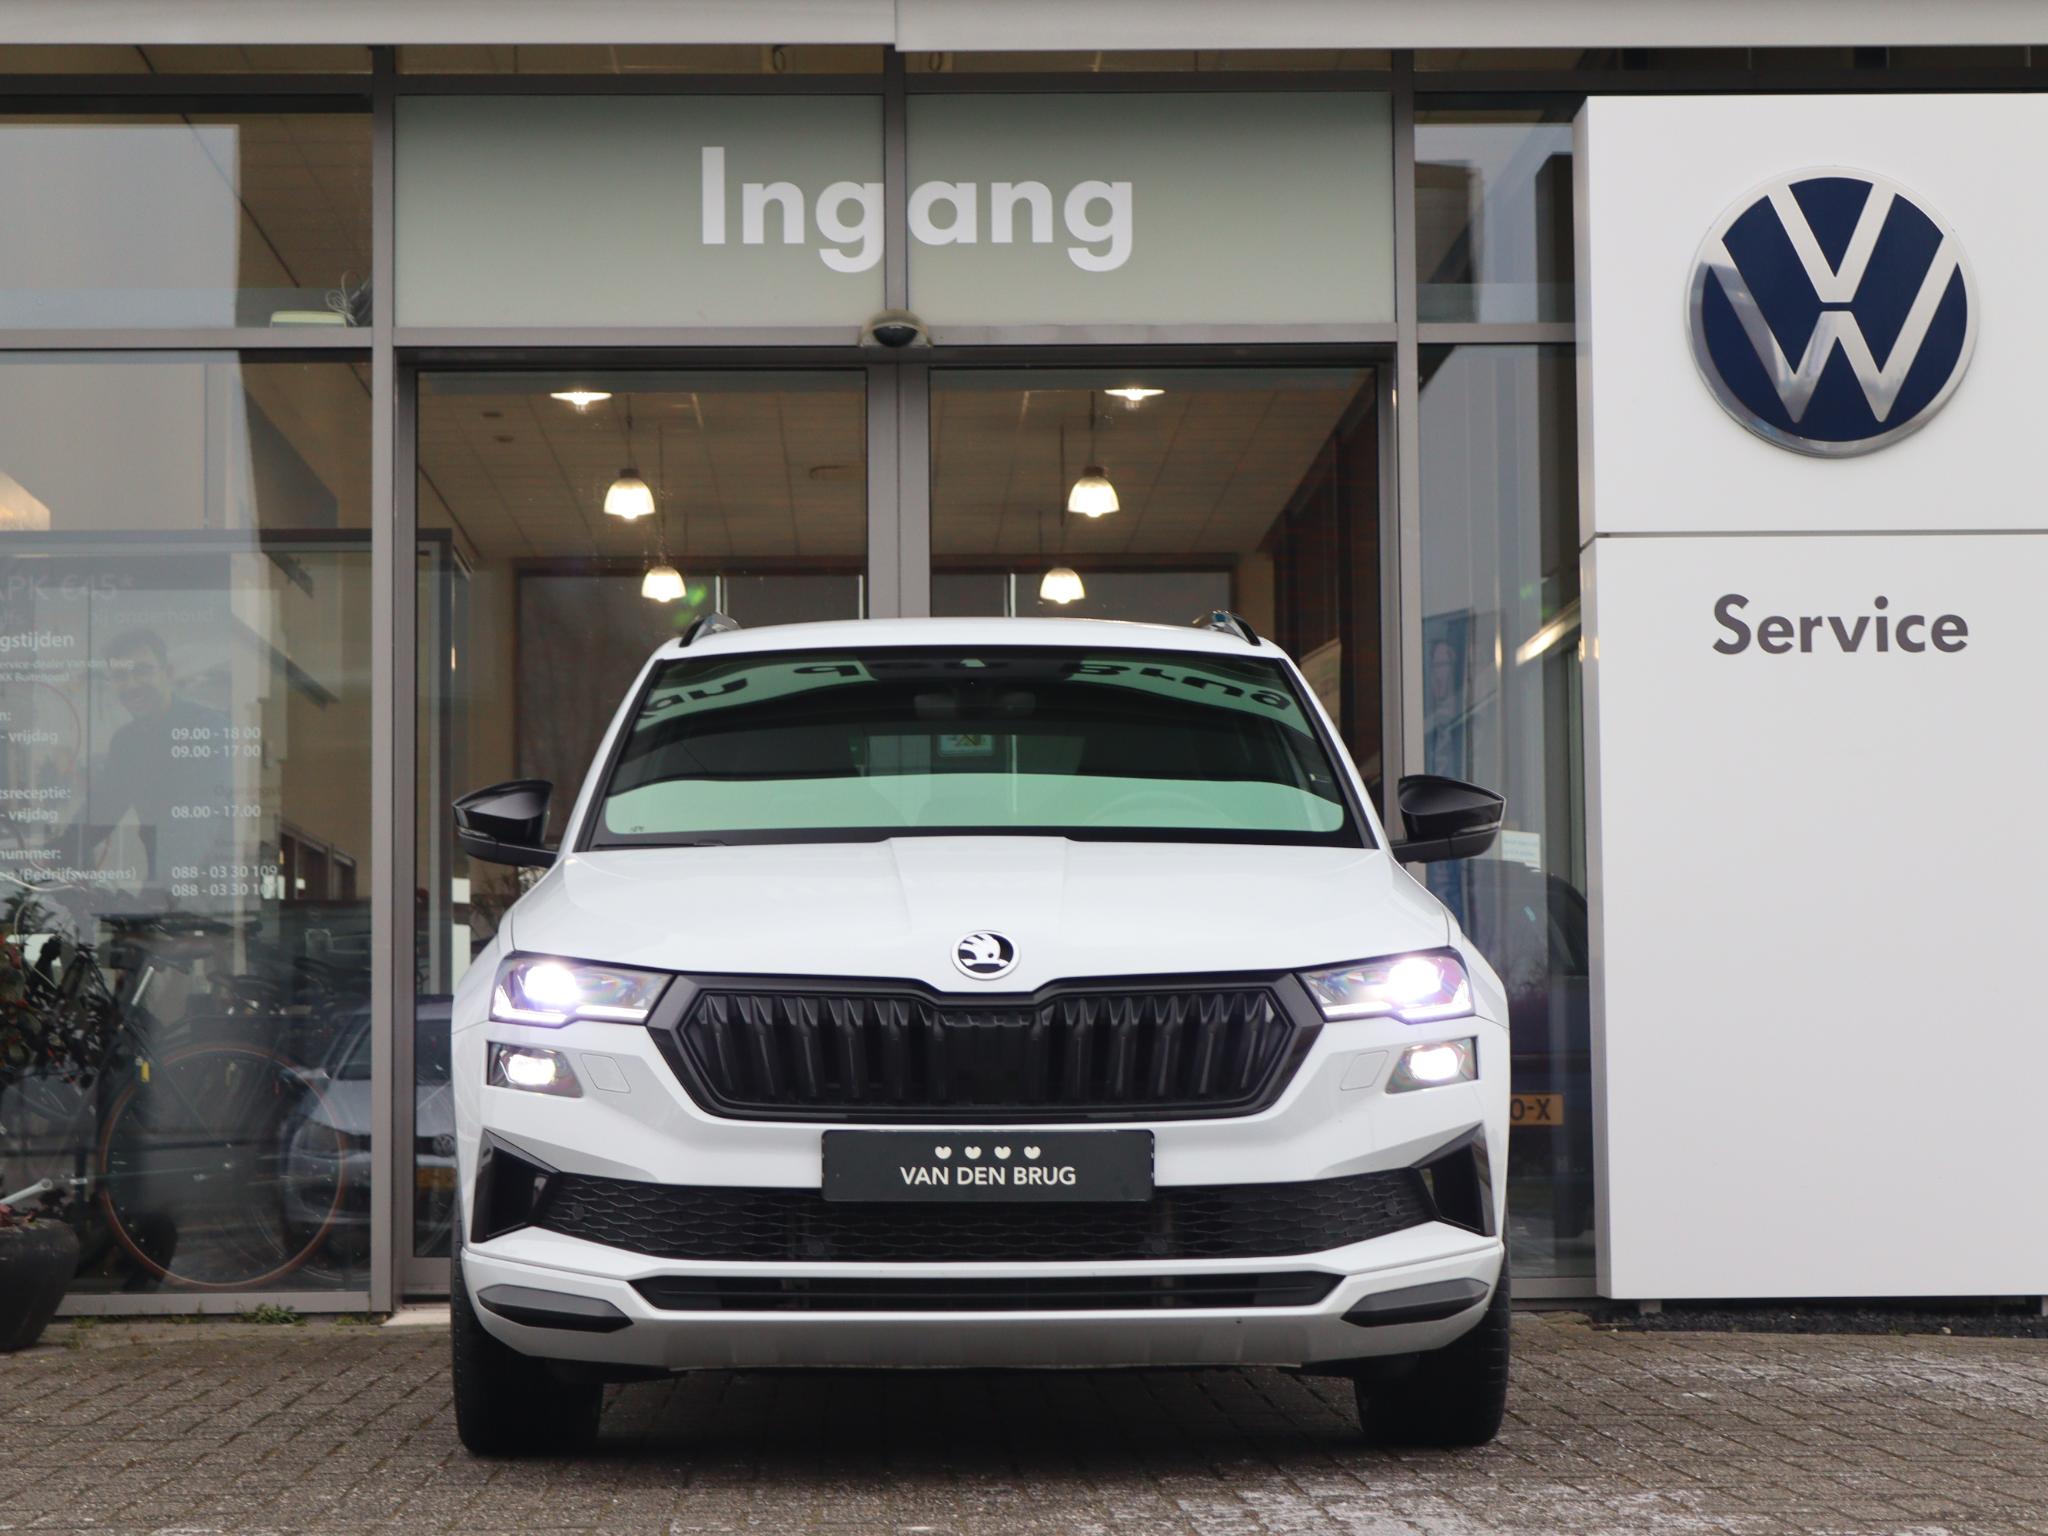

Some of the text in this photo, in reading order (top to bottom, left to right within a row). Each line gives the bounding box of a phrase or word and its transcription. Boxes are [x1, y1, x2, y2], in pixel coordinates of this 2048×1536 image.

[701, 146, 1133, 273] Ingang
[1711, 593, 1969, 656] Service
[0, 631, 75, 652] gstijden
[8, 730, 58, 745] vrijdag
[171, 728, 210, 740] 09.00
[223, 728, 261, 740] 1800
[171, 745, 210, 758] 09.00
[223, 745, 261, 758] 1700
[8, 808, 58, 823] vrijdag
[171, 805, 210, 818] 08.00
[223, 805, 261, 818] 17.00
[172, 866, 198, 879] 088
[210, 866, 227, 879] 03
[231, 866, 248, 879] 30
[172, 883, 198, 896] 088
[210, 883, 227, 896] 03
[231, 883, 248, 896] 30
[900, 1166, 1076, 1186] VAN DEN BRUG
